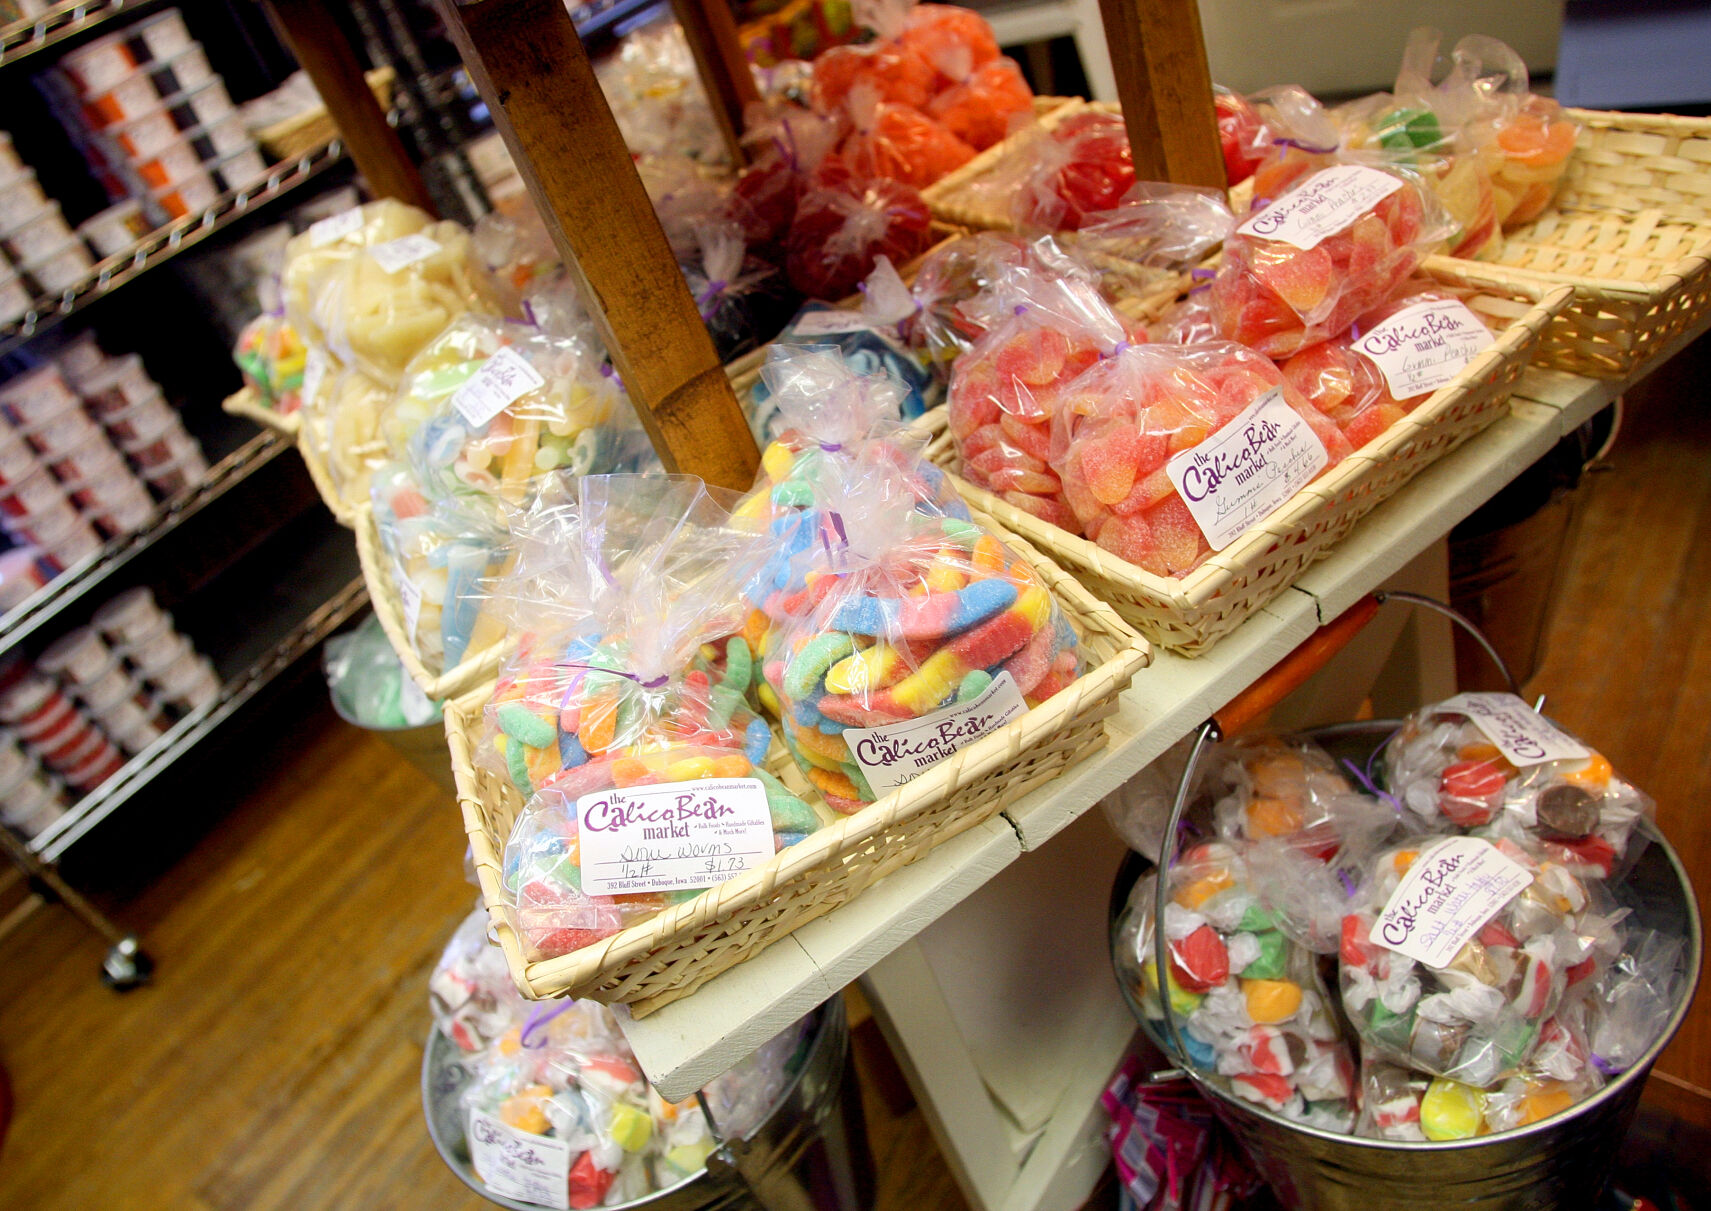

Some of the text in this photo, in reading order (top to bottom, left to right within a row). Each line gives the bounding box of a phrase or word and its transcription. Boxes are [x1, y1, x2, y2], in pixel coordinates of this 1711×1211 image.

[1414, 335, 1447, 352] market
[1193, 452, 1211, 467] the
[1235, 454, 1268, 486] market
[1182, 447, 1250, 502] Calico
[857, 714, 994, 767] Calico Bean
[871, 731, 890, 744] the
[914, 743, 958, 768] market
[609, 793, 627, 805] the
[584, 793, 735, 832] Calico Bean
[643, 820, 691, 840] market
[618, 880, 631, 889] Bluff
[631, 879, 647, 888] Street
[1427, 882, 1457, 915] market
